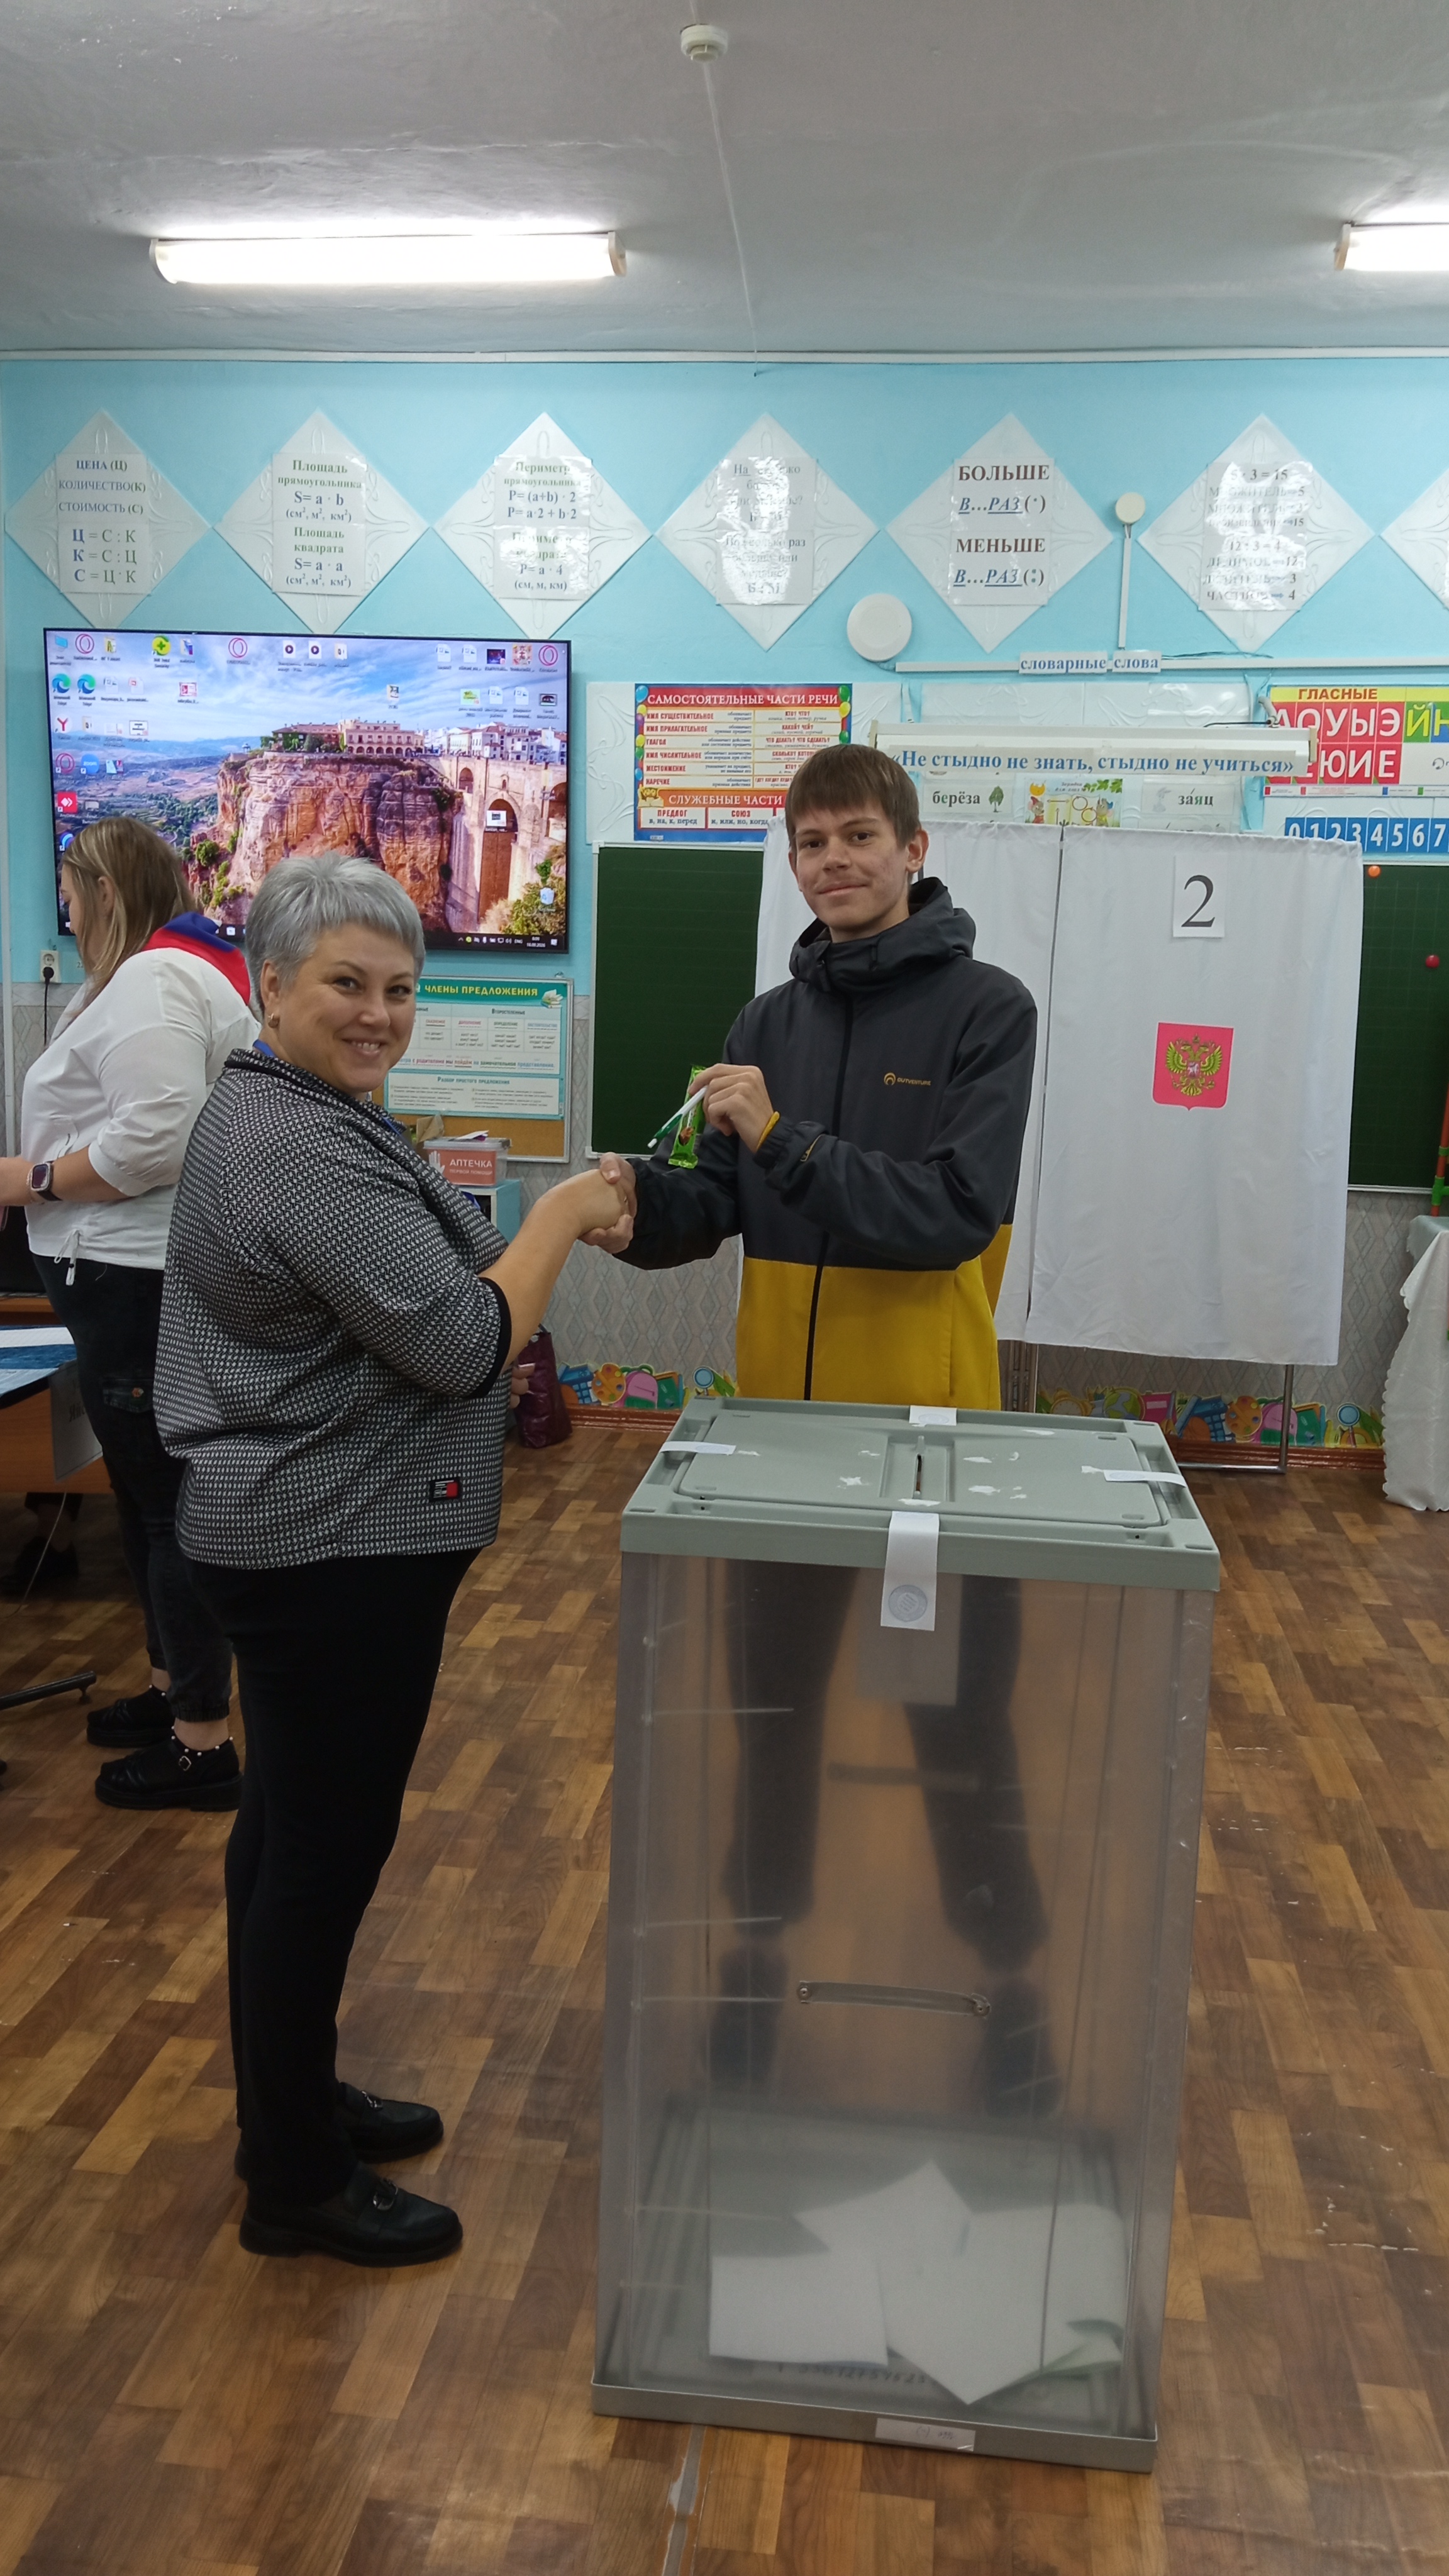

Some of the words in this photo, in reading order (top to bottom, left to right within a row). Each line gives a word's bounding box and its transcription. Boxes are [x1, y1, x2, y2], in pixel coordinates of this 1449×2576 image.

[76, 460, 108, 470] ЦЕНА
[110, 460, 128, 471] (Ц)
[292, 460, 348, 474] Площадь
[516, 462, 570, 475] Периметр
[734, 464, 748, 475] На
[958, 465, 1050, 481] БОЛЬШЕ
[1250, 469, 1257, 480] 3
[1275, 469, 1288, 480] 15
[58, 480, 146, 493] КОЛИЧЕСТВО(К)
[278, 477, 362, 489] прямоугольника
[336, 494, 344, 506] b
[570, 492, 576, 502] 2
[58, 502, 125, 513] СТОИМОСТЬ
[128, 504, 143, 515] (С)
[1294, 518, 1304, 526] 15
[72, 529, 85, 544] Ц
[102, 529, 112, 542] С
[126, 530, 136, 543] К
[294, 527, 345, 538] Площадь
[294, 544, 344, 555] квадрата
[789, 539, 806, 549] раз
[956, 538, 1045, 553] МЕНЬШЕ
[73, 549, 84, 562] К
[102, 550, 112, 562] С
[125, 550, 136, 565] Ц
[74, 569, 86, 582] С
[104, 570, 116, 585] Ц
[126, 570, 136, 583] К
[1289, 574, 1296, 584] 3
[1288, 589, 1296, 600] 4
[1021, 658, 1106, 673] словарные
[1114, 658, 1158, 669] слова
[647, 694, 764, 704] САМОСТОЯТЕЛЬНЫЕ
[767, 694, 805, 704] ЧАСТИ
[808, 694, 838, 704] РЕЧИ
[1298, 688, 1378, 700] ГЛАСНЫЕ
[1325, 708, 1348, 736] У
[1351, 708, 1375, 736] Ы
[1380, 708, 1401, 736] Э
[1406, 704, 1430, 736] Й
[931, 754, 1002, 769] стыдно
[1007, 757, 1028, 769] не
[1034, 757, 1093, 773] знать,
[1098, 757, 1169, 771] стыдно
[1175, 758, 1197, 770] не
[1201, 758, 1294, 775] учиться»
[1319, 750, 1346, 777] Ю
[1348, 750, 1372, 777] И
[1379, 750, 1396, 777] Е
[669, 795, 740, 805] СЛУЖЕБНЫЕ
[743, 795, 782, 805] ЧАСТИ
[933, 791, 980, 807] берёза
[657, 809, 687, 818] ПРЕДЛОГ
[1370, 824, 1383, 846] 4
[1391, 824, 1404, 847] 5
[1413, 824, 1425, 847] 6
[1434, 824, 1446, 847] 7
[1181, 875, 1215, 928] 2
[425, 985, 458, 994] ЧЛЕНЫ
[462, 986, 538, 996] ПРЕДЛОЖЕНИЯ
[897, 1077, 931, 1086] OUTVENTURE
[450, 1158, 492, 1168] АПТЕЧКА
